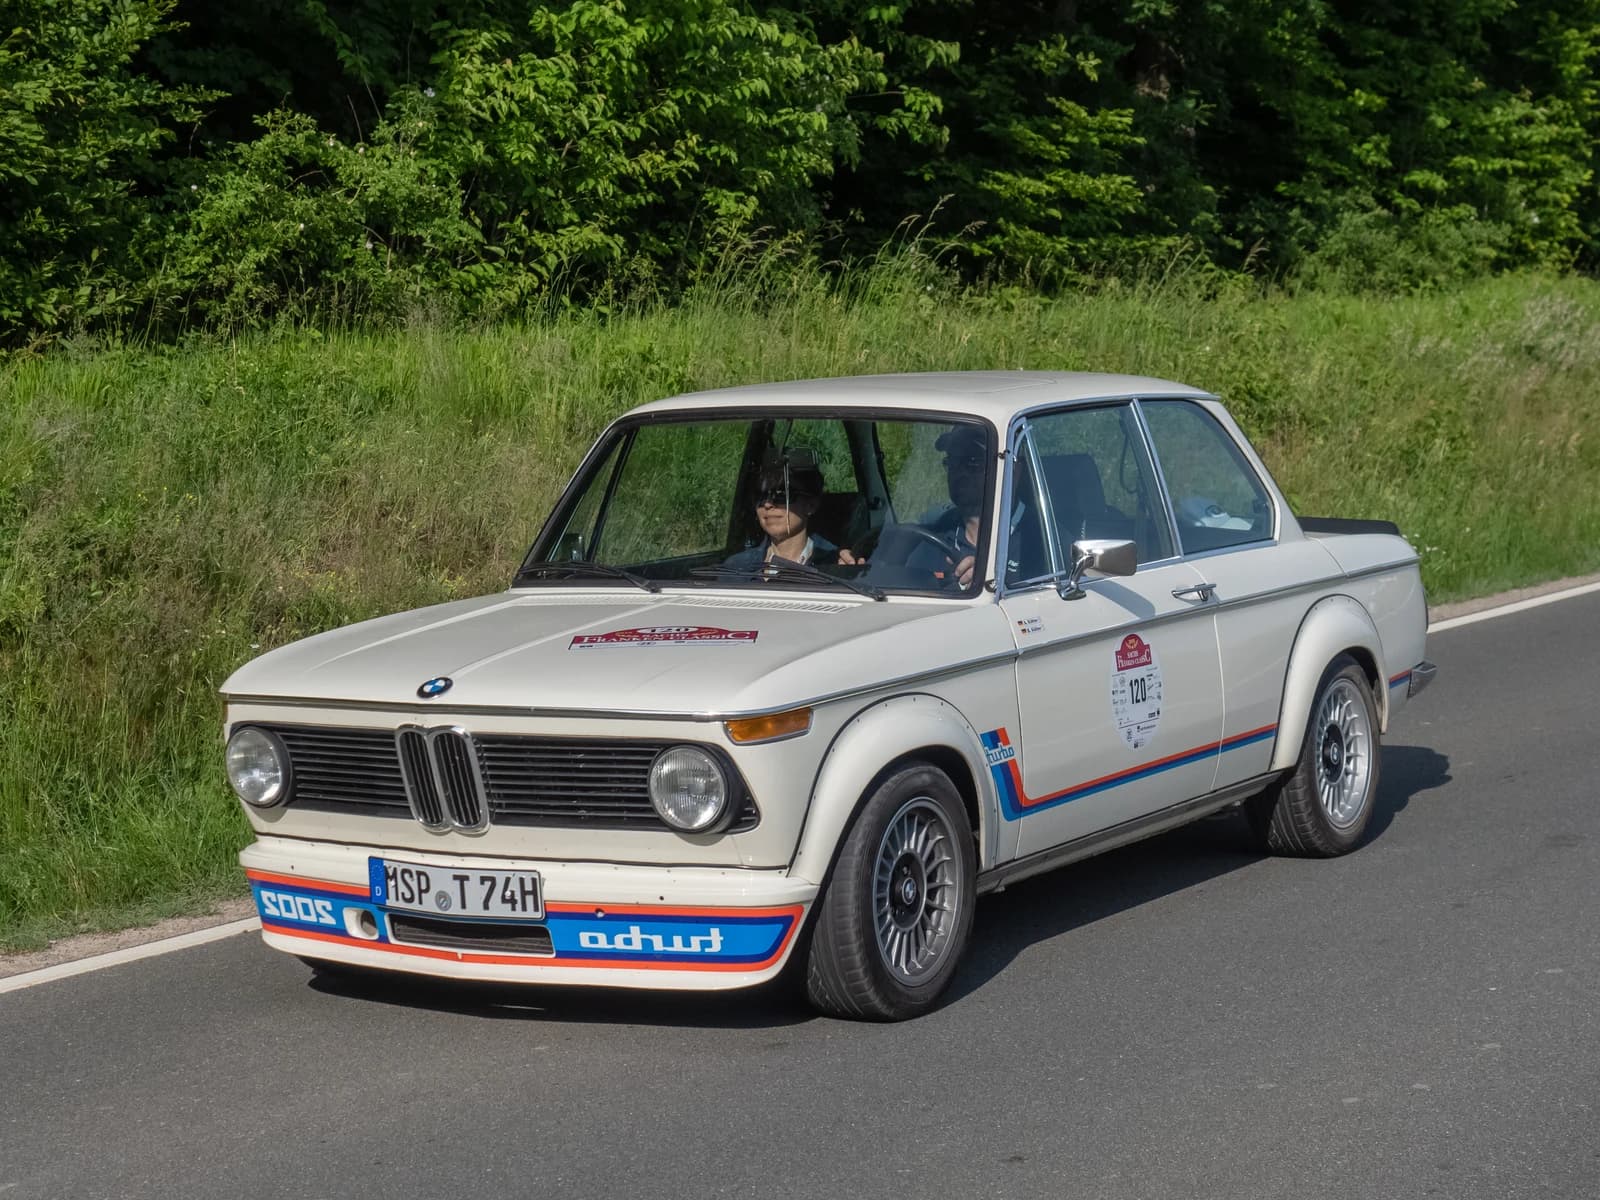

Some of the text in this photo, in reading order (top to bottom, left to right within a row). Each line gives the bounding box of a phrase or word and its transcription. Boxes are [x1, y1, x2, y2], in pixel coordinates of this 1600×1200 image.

[669, 632, 751, 640] CLASSIC
[1129, 677, 1147, 704] 120
[375, 886, 382, 896] D
[384, 865, 539, 912] MSP T 74H
